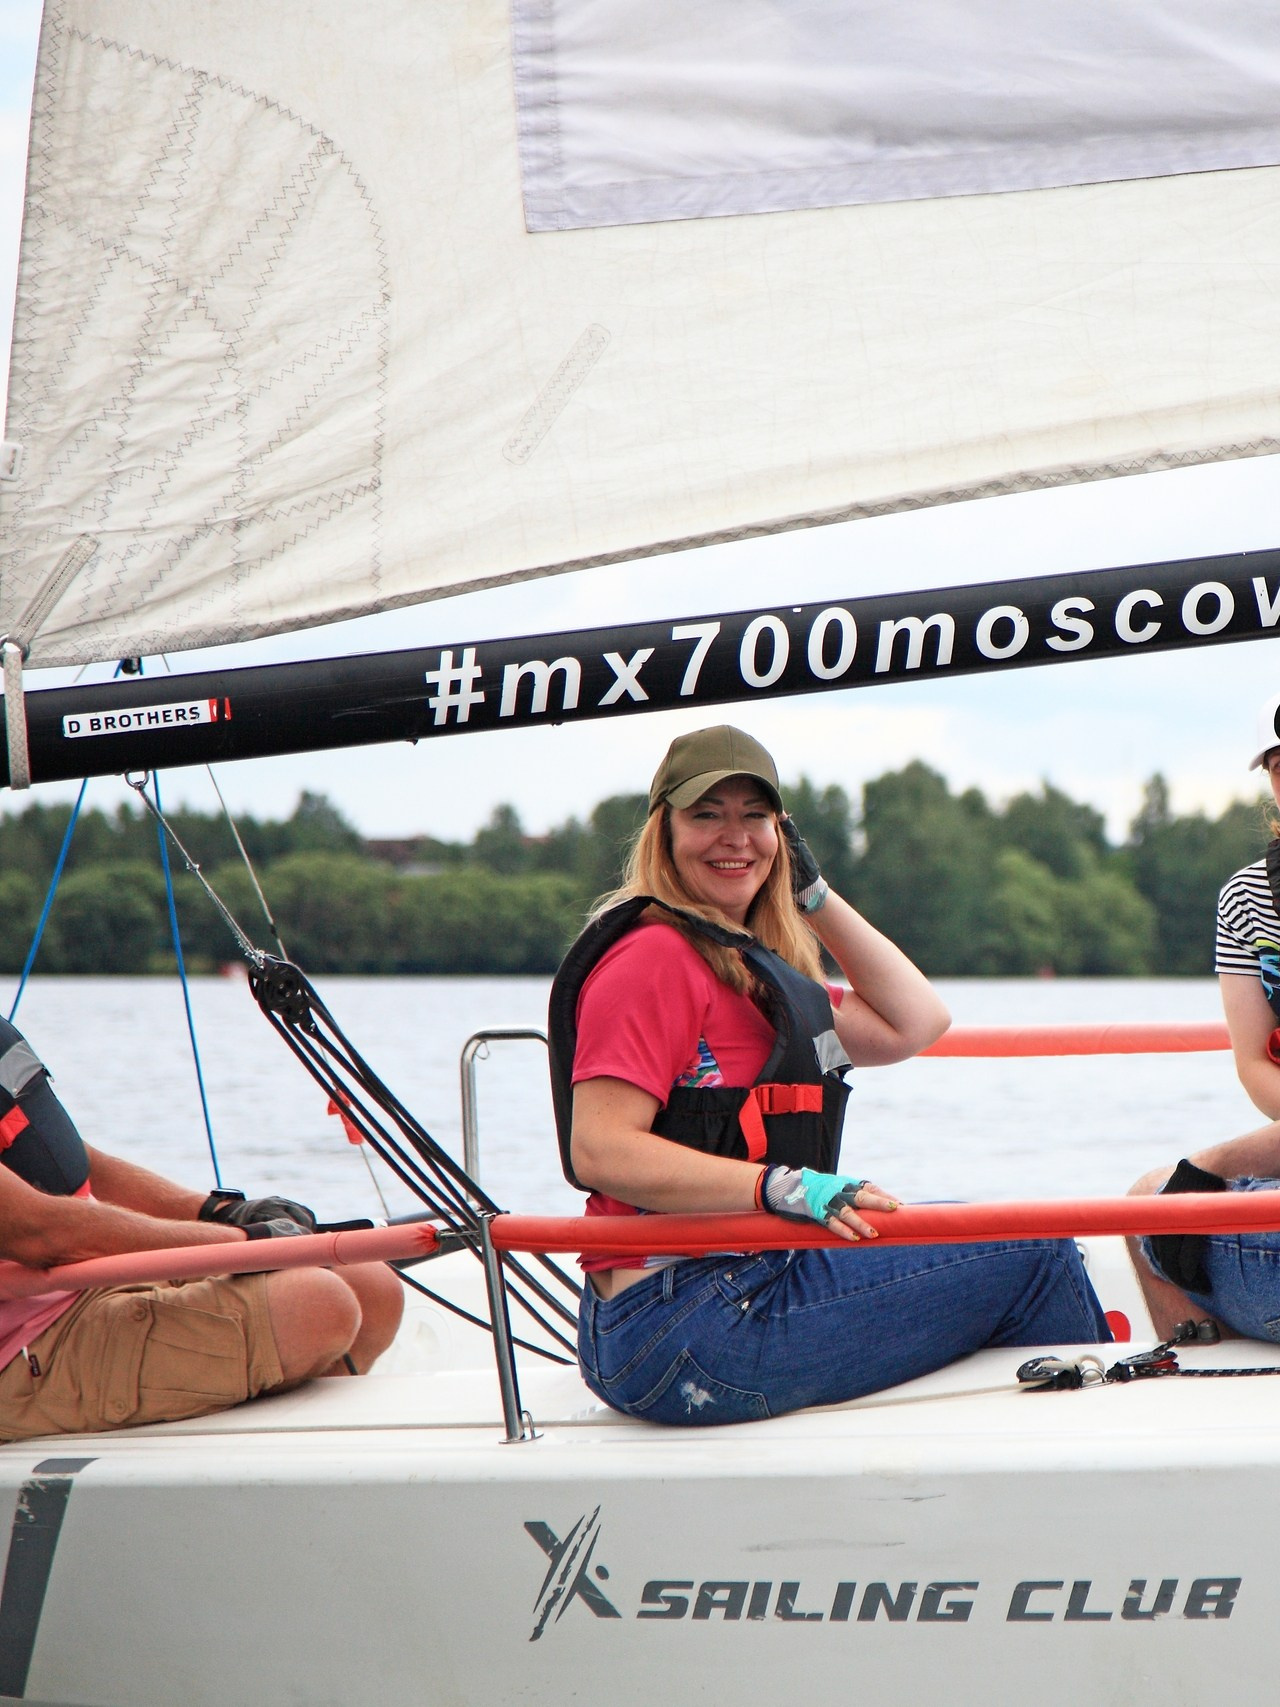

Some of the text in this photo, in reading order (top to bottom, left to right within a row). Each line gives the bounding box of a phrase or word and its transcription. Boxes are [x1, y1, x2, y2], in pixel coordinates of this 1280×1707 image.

[68, 706, 200, 734] D BROTHERS
[636, 1579, 979, 1622] SAILING
[1006, 1577, 1242, 1622] CLUB
